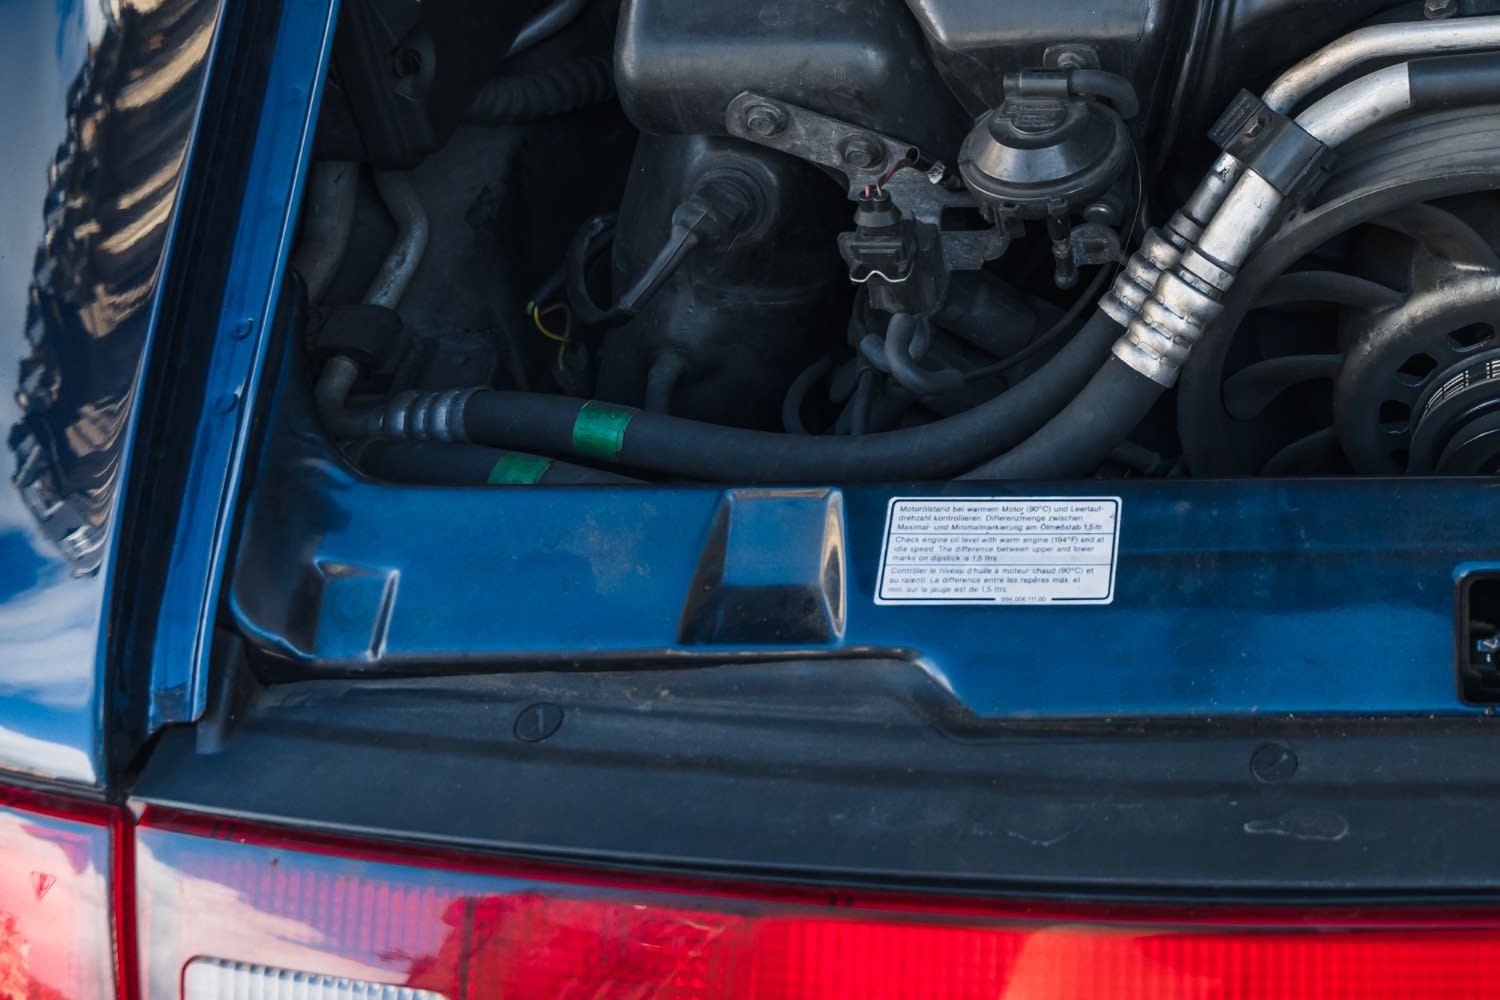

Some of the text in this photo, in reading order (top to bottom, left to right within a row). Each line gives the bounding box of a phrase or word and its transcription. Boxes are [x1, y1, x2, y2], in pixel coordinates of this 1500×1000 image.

[1054, 505, 1068, 513] und
[922, 536, 948, 544] engine
[1023, 536, 1049, 544] engine
[1032, 546, 1054, 554] upper
[1032, 566, 1055, 574] chaud
